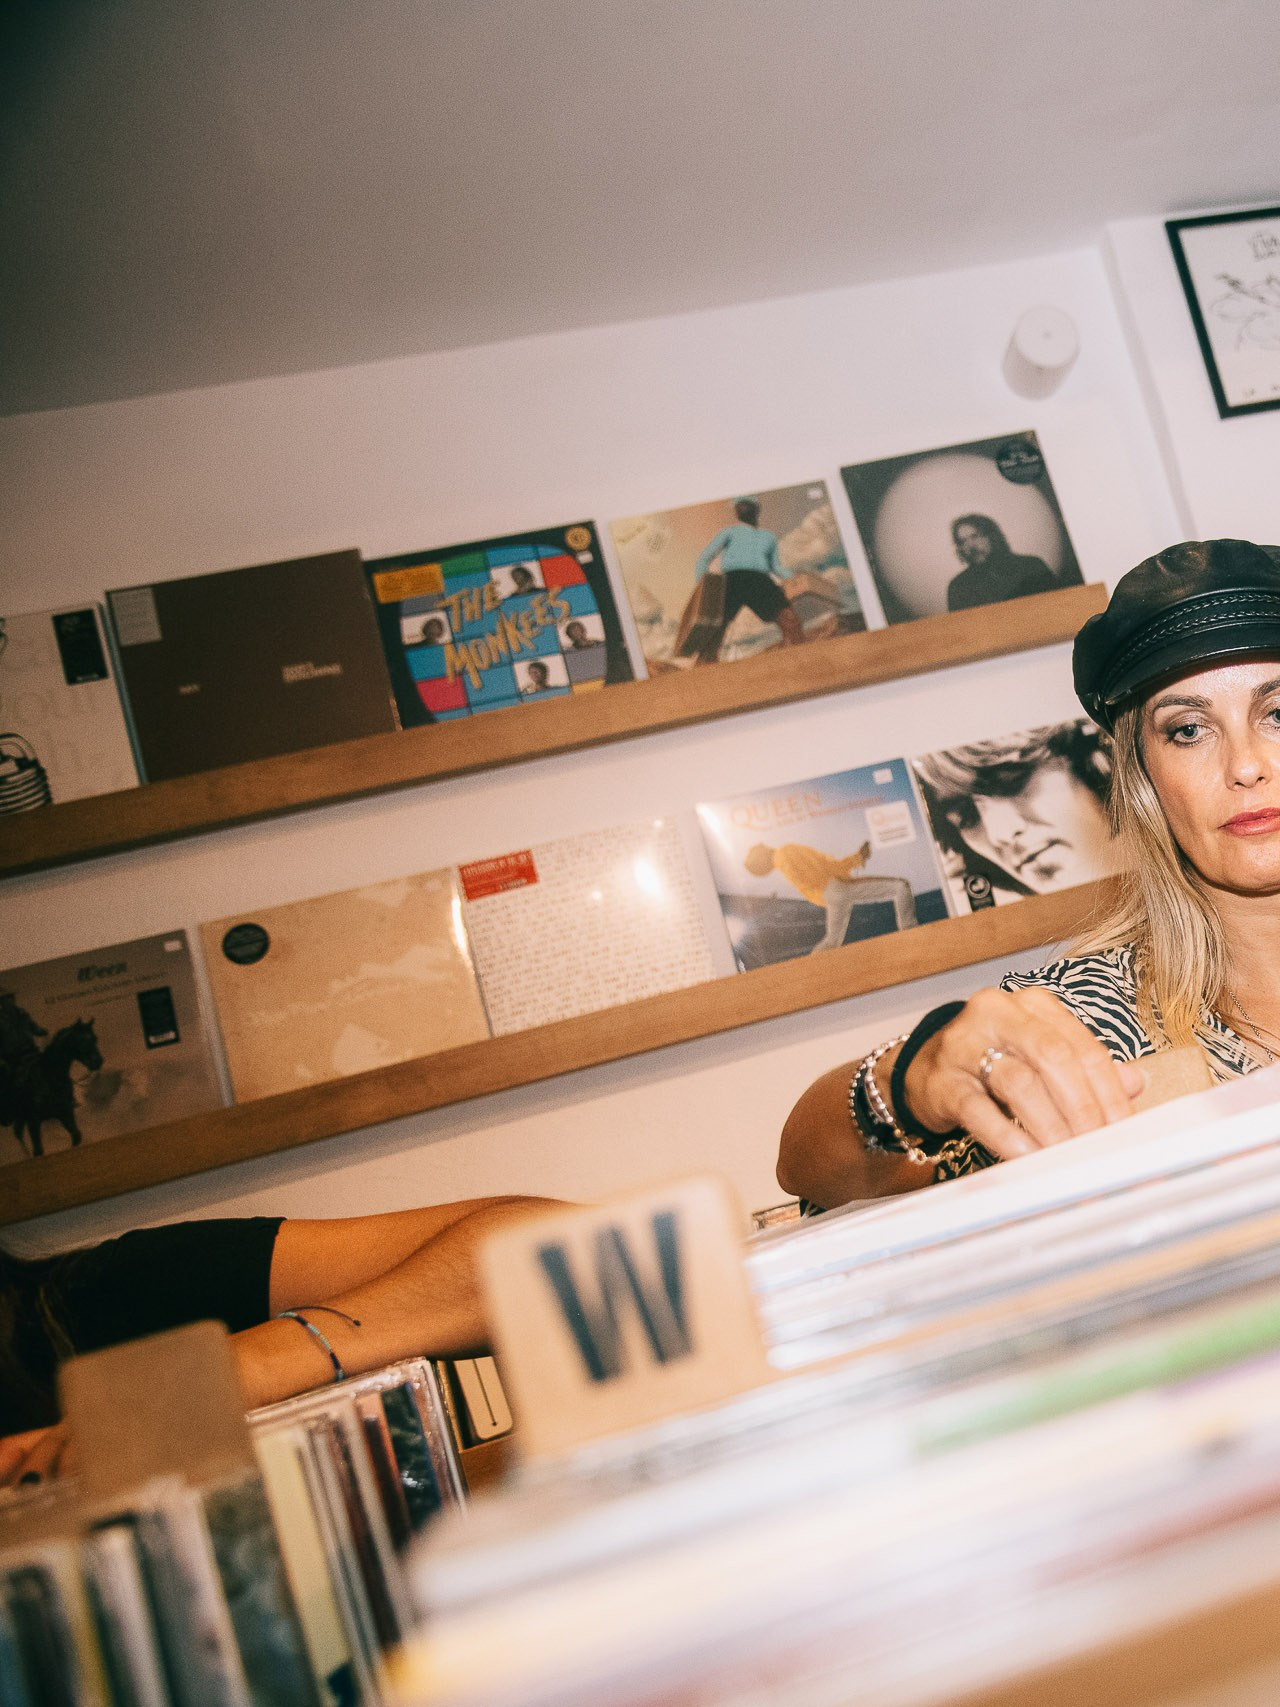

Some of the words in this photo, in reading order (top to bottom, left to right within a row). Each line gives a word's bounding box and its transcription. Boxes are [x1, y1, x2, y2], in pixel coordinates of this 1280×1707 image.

[434, 580, 501, 632] THE
[443, 586, 571, 691] MONKEES
[730, 790, 822, 832] QUEEN
[535, 1211, 696, 1385] W
